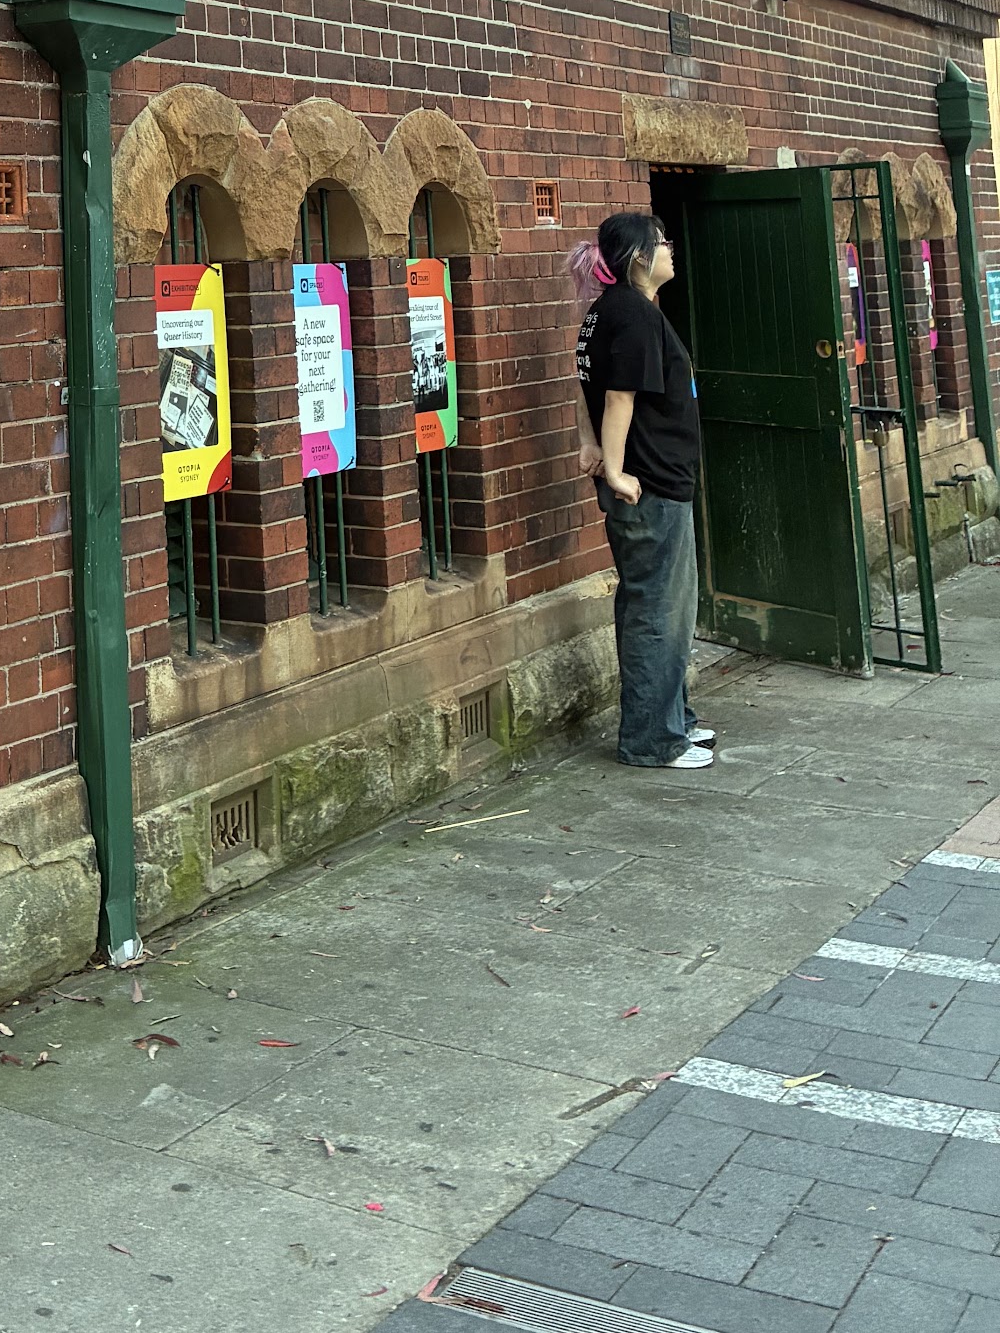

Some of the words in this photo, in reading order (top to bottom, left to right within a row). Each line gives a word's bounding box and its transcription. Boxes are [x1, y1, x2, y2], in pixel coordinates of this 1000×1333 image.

[171, 284, 200, 292] EXHIBITIONS
[162, 319, 193, 331] Uncovering
[194, 319, 204, 327] our
[303, 319, 309, 330] A
[310, 320, 326, 329] new
[164, 331, 181, 342] Queer
[182, 330, 203, 341] History
[296, 334, 312, 346] safe
[312, 334, 334, 346] space
[301, 349, 312, 362] for
[313, 350, 331, 362] your
[309, 366, 325, 376] next
[298, 378, 336, 396] gathering!
[177, 464, 201, 474] QTOPIA
[180, 474, 199, 483] SYDNEY
